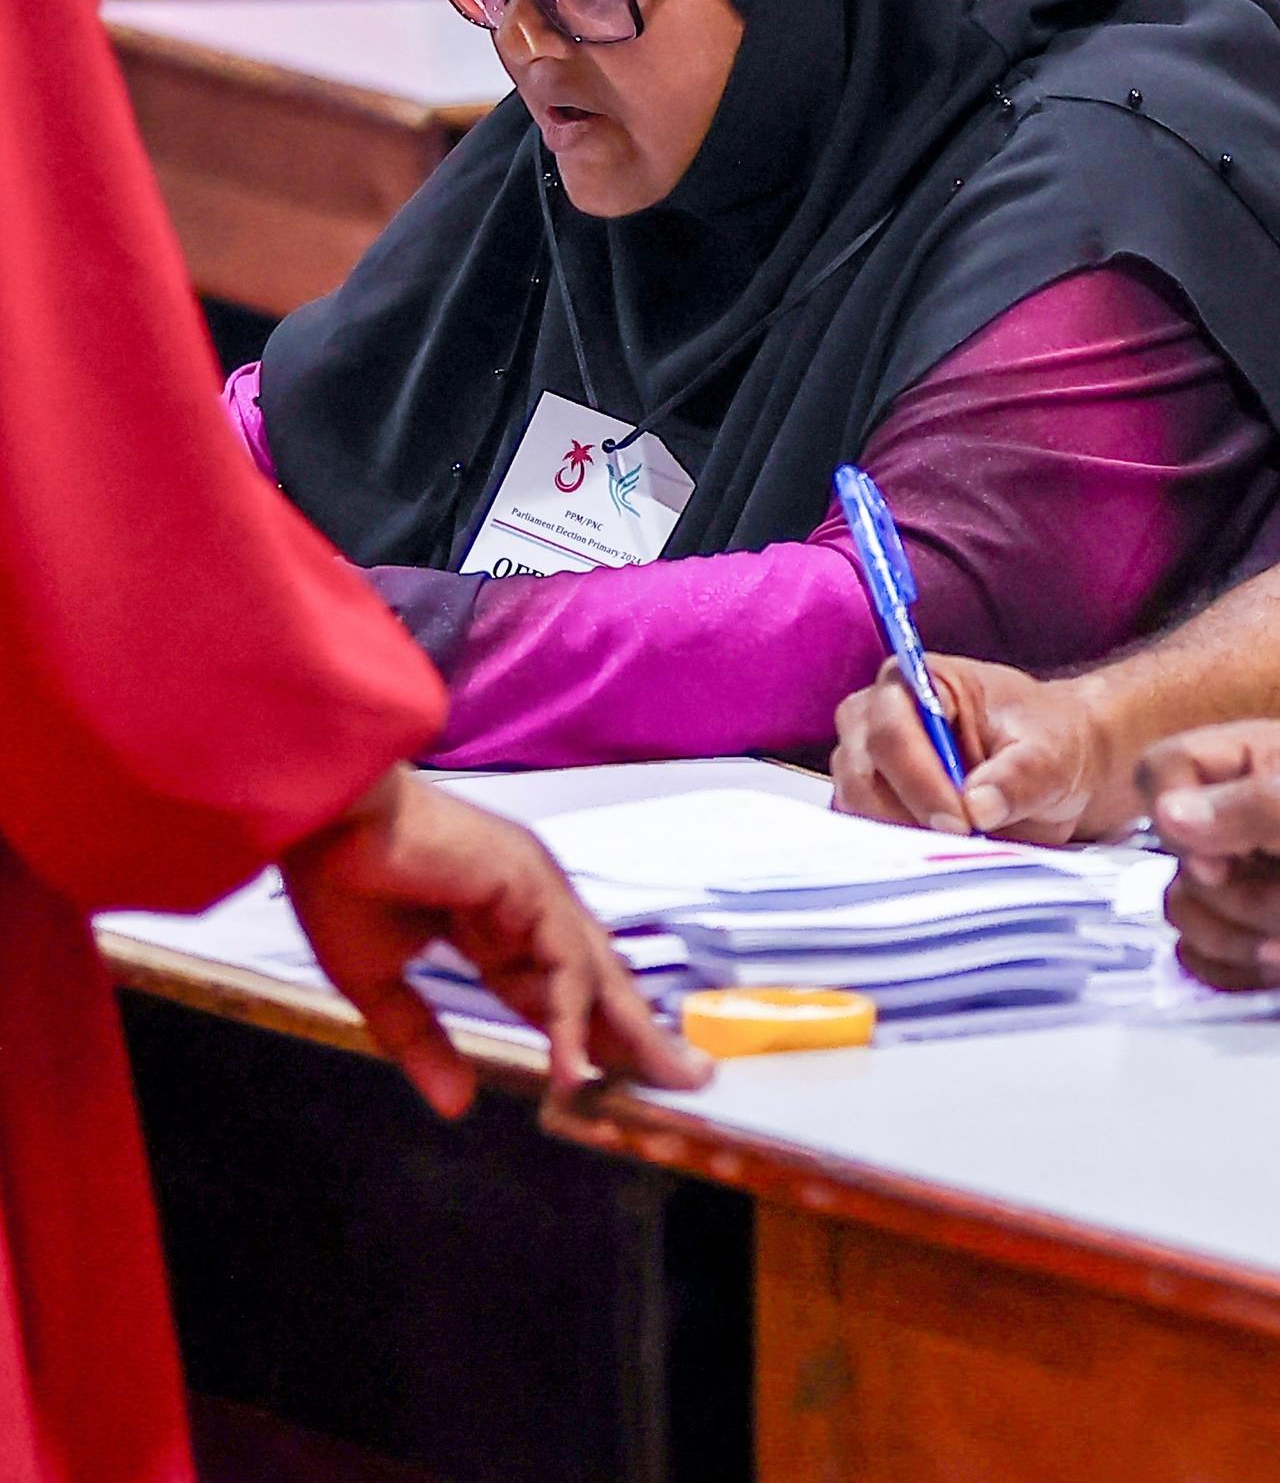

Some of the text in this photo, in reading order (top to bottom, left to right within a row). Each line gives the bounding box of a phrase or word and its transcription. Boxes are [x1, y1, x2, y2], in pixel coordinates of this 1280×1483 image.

[511, 507, 555, 532] Parliament
[555, 525, 587, 544] Election
[587, 538, 620, 559] Primary
[564, 510, 604, 532] PPM/PNC
